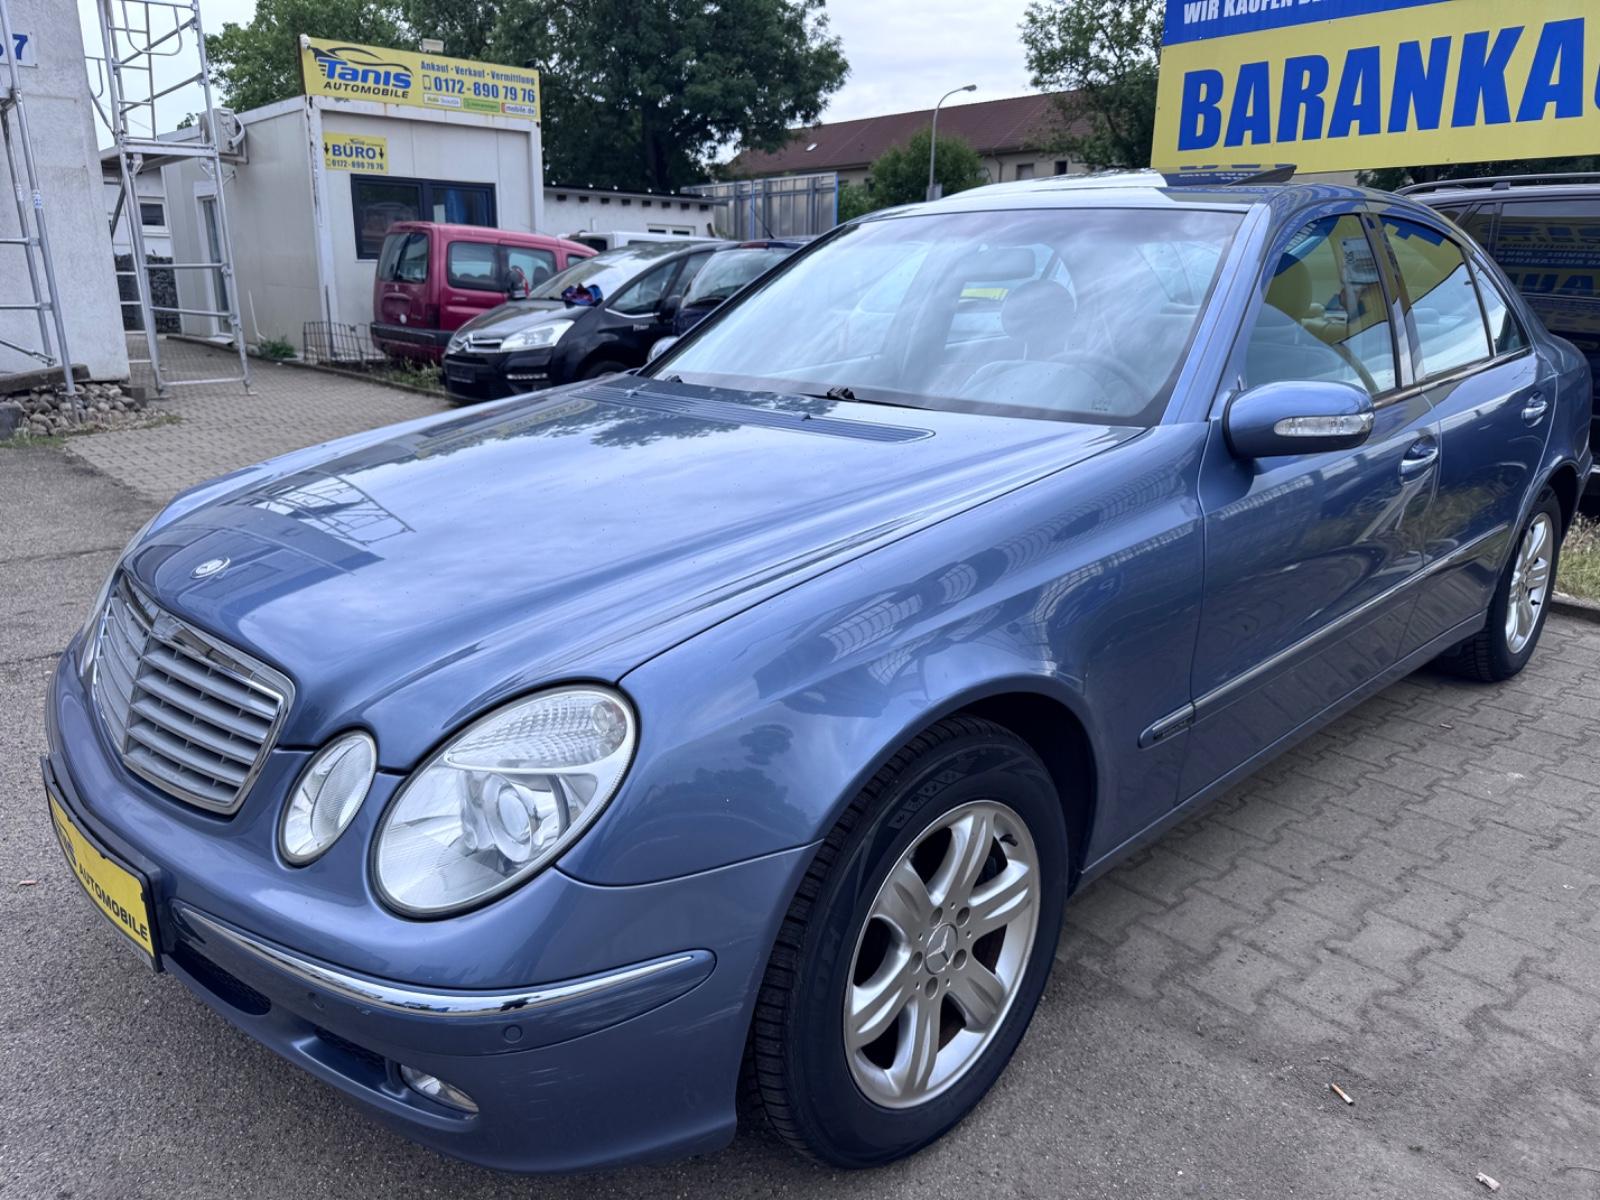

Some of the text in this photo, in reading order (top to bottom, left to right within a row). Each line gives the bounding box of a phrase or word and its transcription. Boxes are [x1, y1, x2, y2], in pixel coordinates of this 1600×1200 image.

[1184, 0, 1219, 24] WIR
[317, 58, 411, 89] Tanis
[421, 60, 535, 86] Ankauf Verkauf Vermittlung
[1178, 17, 1600, 151] BARANKA
[323, 81, 409, 99] AUTOMOBILE
[502, 85, 517, 101] 79
[520, 88, 535, 103] 76
[332, 142, 376, 160] BÜRO
[79, 864, 149, 942] AUTOMOBILE
